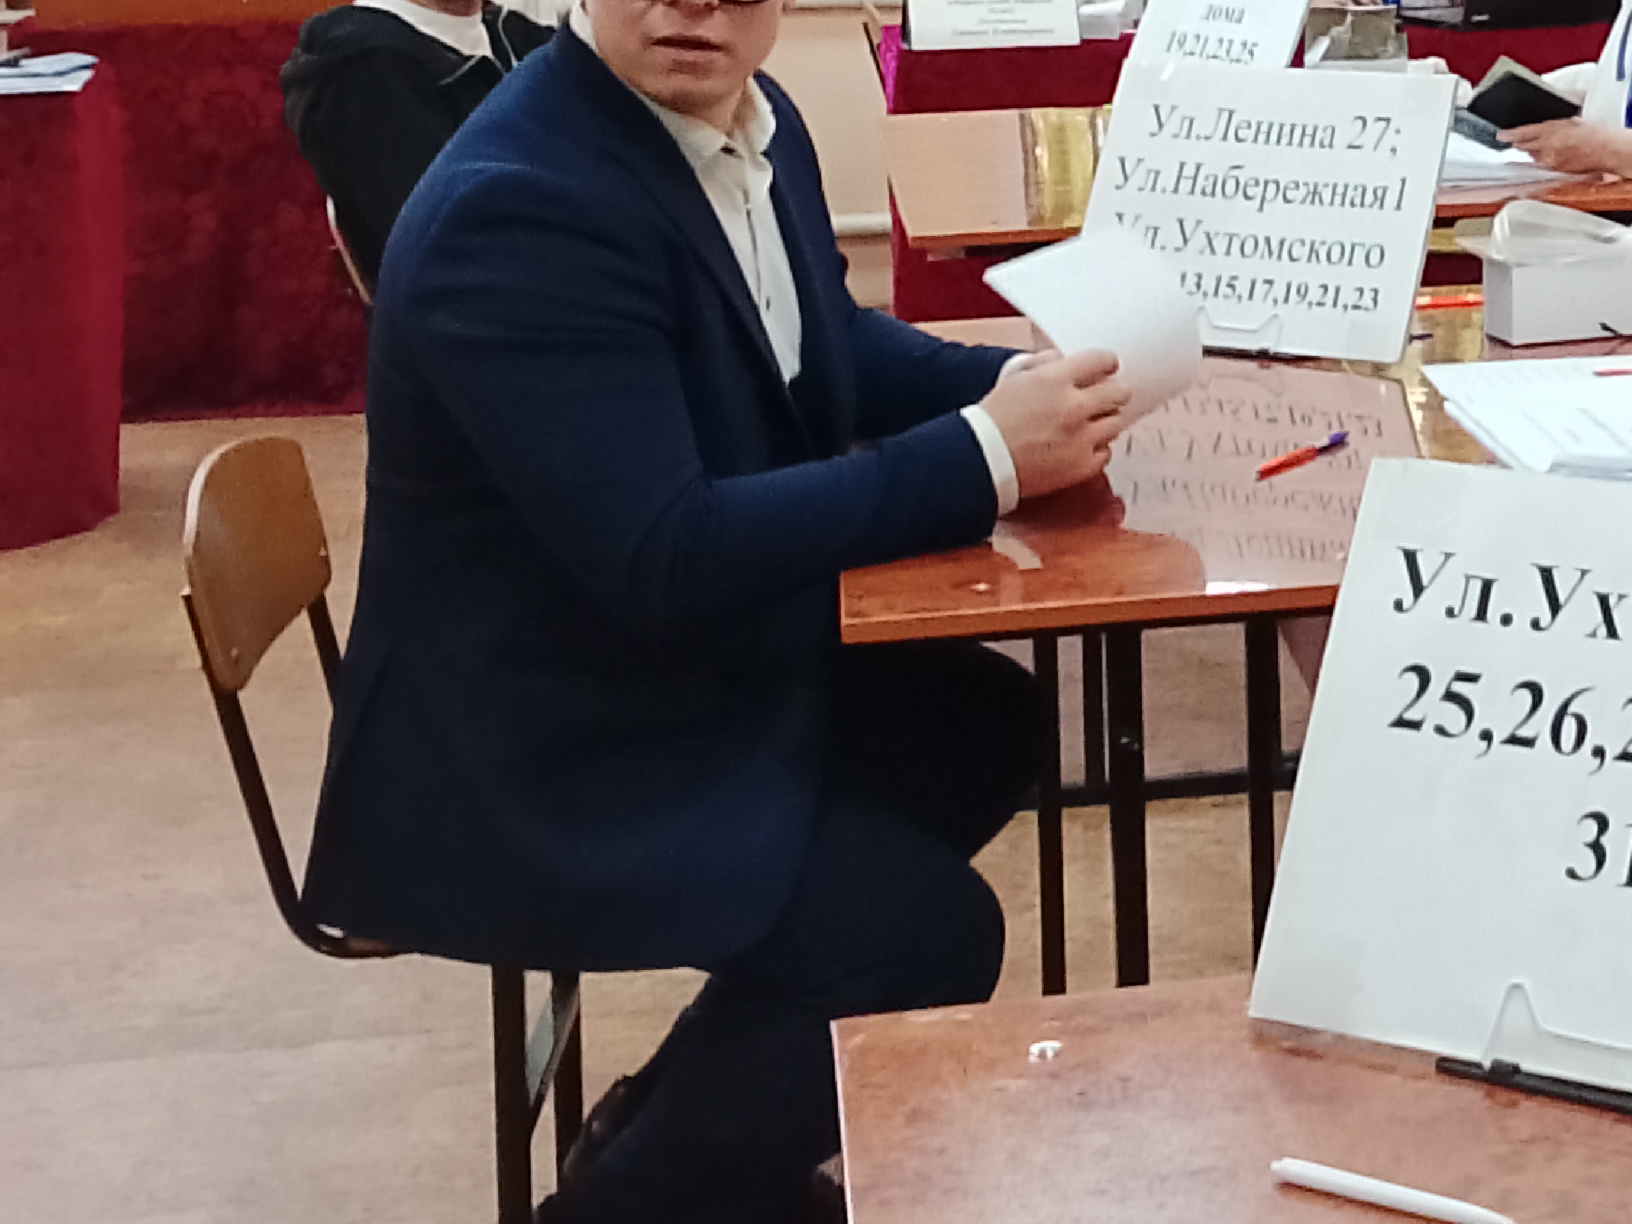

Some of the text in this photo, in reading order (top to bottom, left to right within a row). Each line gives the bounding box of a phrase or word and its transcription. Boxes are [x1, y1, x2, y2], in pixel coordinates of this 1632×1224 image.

[1202, 3, 1245, 24] дома
[1149, 103, 1402, 158] Ул.Ленина 27;
